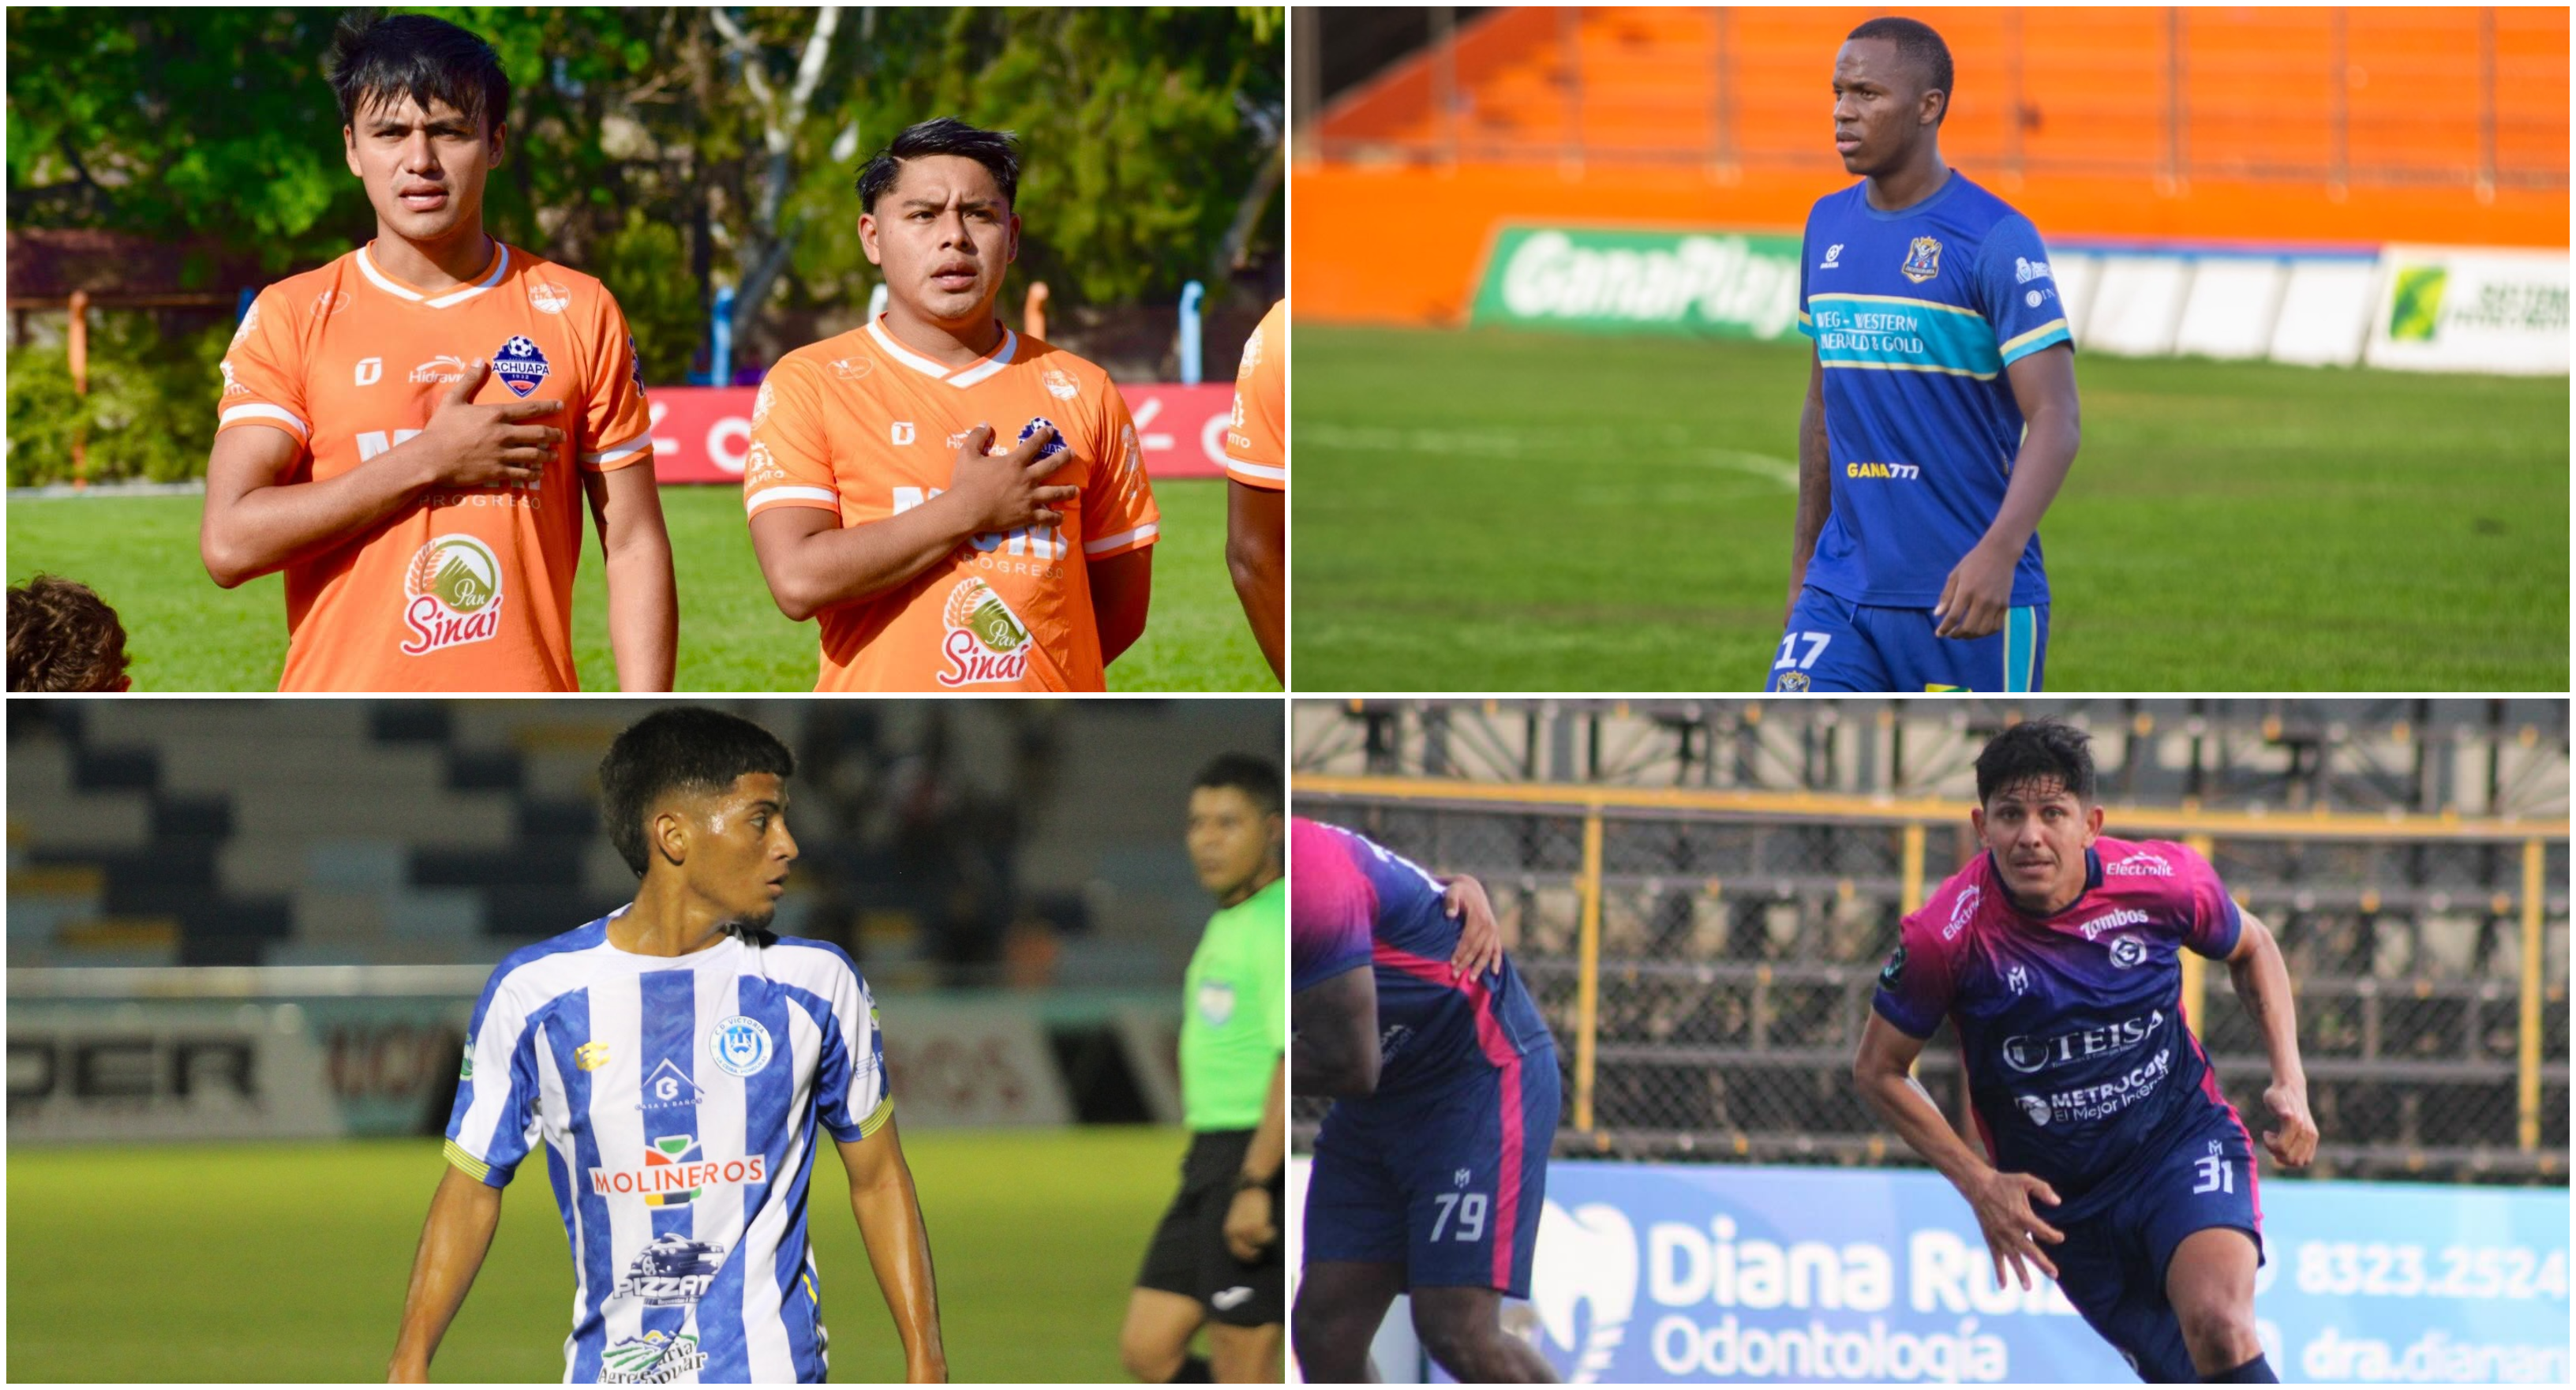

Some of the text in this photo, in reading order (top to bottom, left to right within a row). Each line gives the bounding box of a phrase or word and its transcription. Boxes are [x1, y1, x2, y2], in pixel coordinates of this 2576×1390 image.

[1503, 230, 1800, 341] GanaPlay
[1854, 313, 1918, 332] WESTERN
[1820, 332, 1869, 350] MERALD
[1882, 336, 1923, 354] GOLD
[492, 362, 550, 376] ACHUAPA
[1847, 463, 1919, 480] GANA777
[419, 493, 541, 510] PROGRESO
[957, 553, 1064, 579] ROGRESO
[450, 579, 485, 606] Pan
[403, 596, 500, 654] Sinaí
[985, 620, 1017, 648] Pan
[939, 629, 1030, 684] Sinaí
[1775, 632, 1831, 669] 17
[728, 1017, 764, 1034] VICTORIA
[2050, 1009, 2164, 1061] TEISA
[672, 1097, 703, 1107] BAÑOS
[2054, 1109, 2069, 1122] El
[594, 1159, 763, 1193] MOLINEROS
[2193, 1156, 2233, 1194] 31
[1430, 1193, 1488, 1242] 79
[1648, 1213, 1893, 1313] Diana
[1650, 1313, 2009, 1383] Odontología
